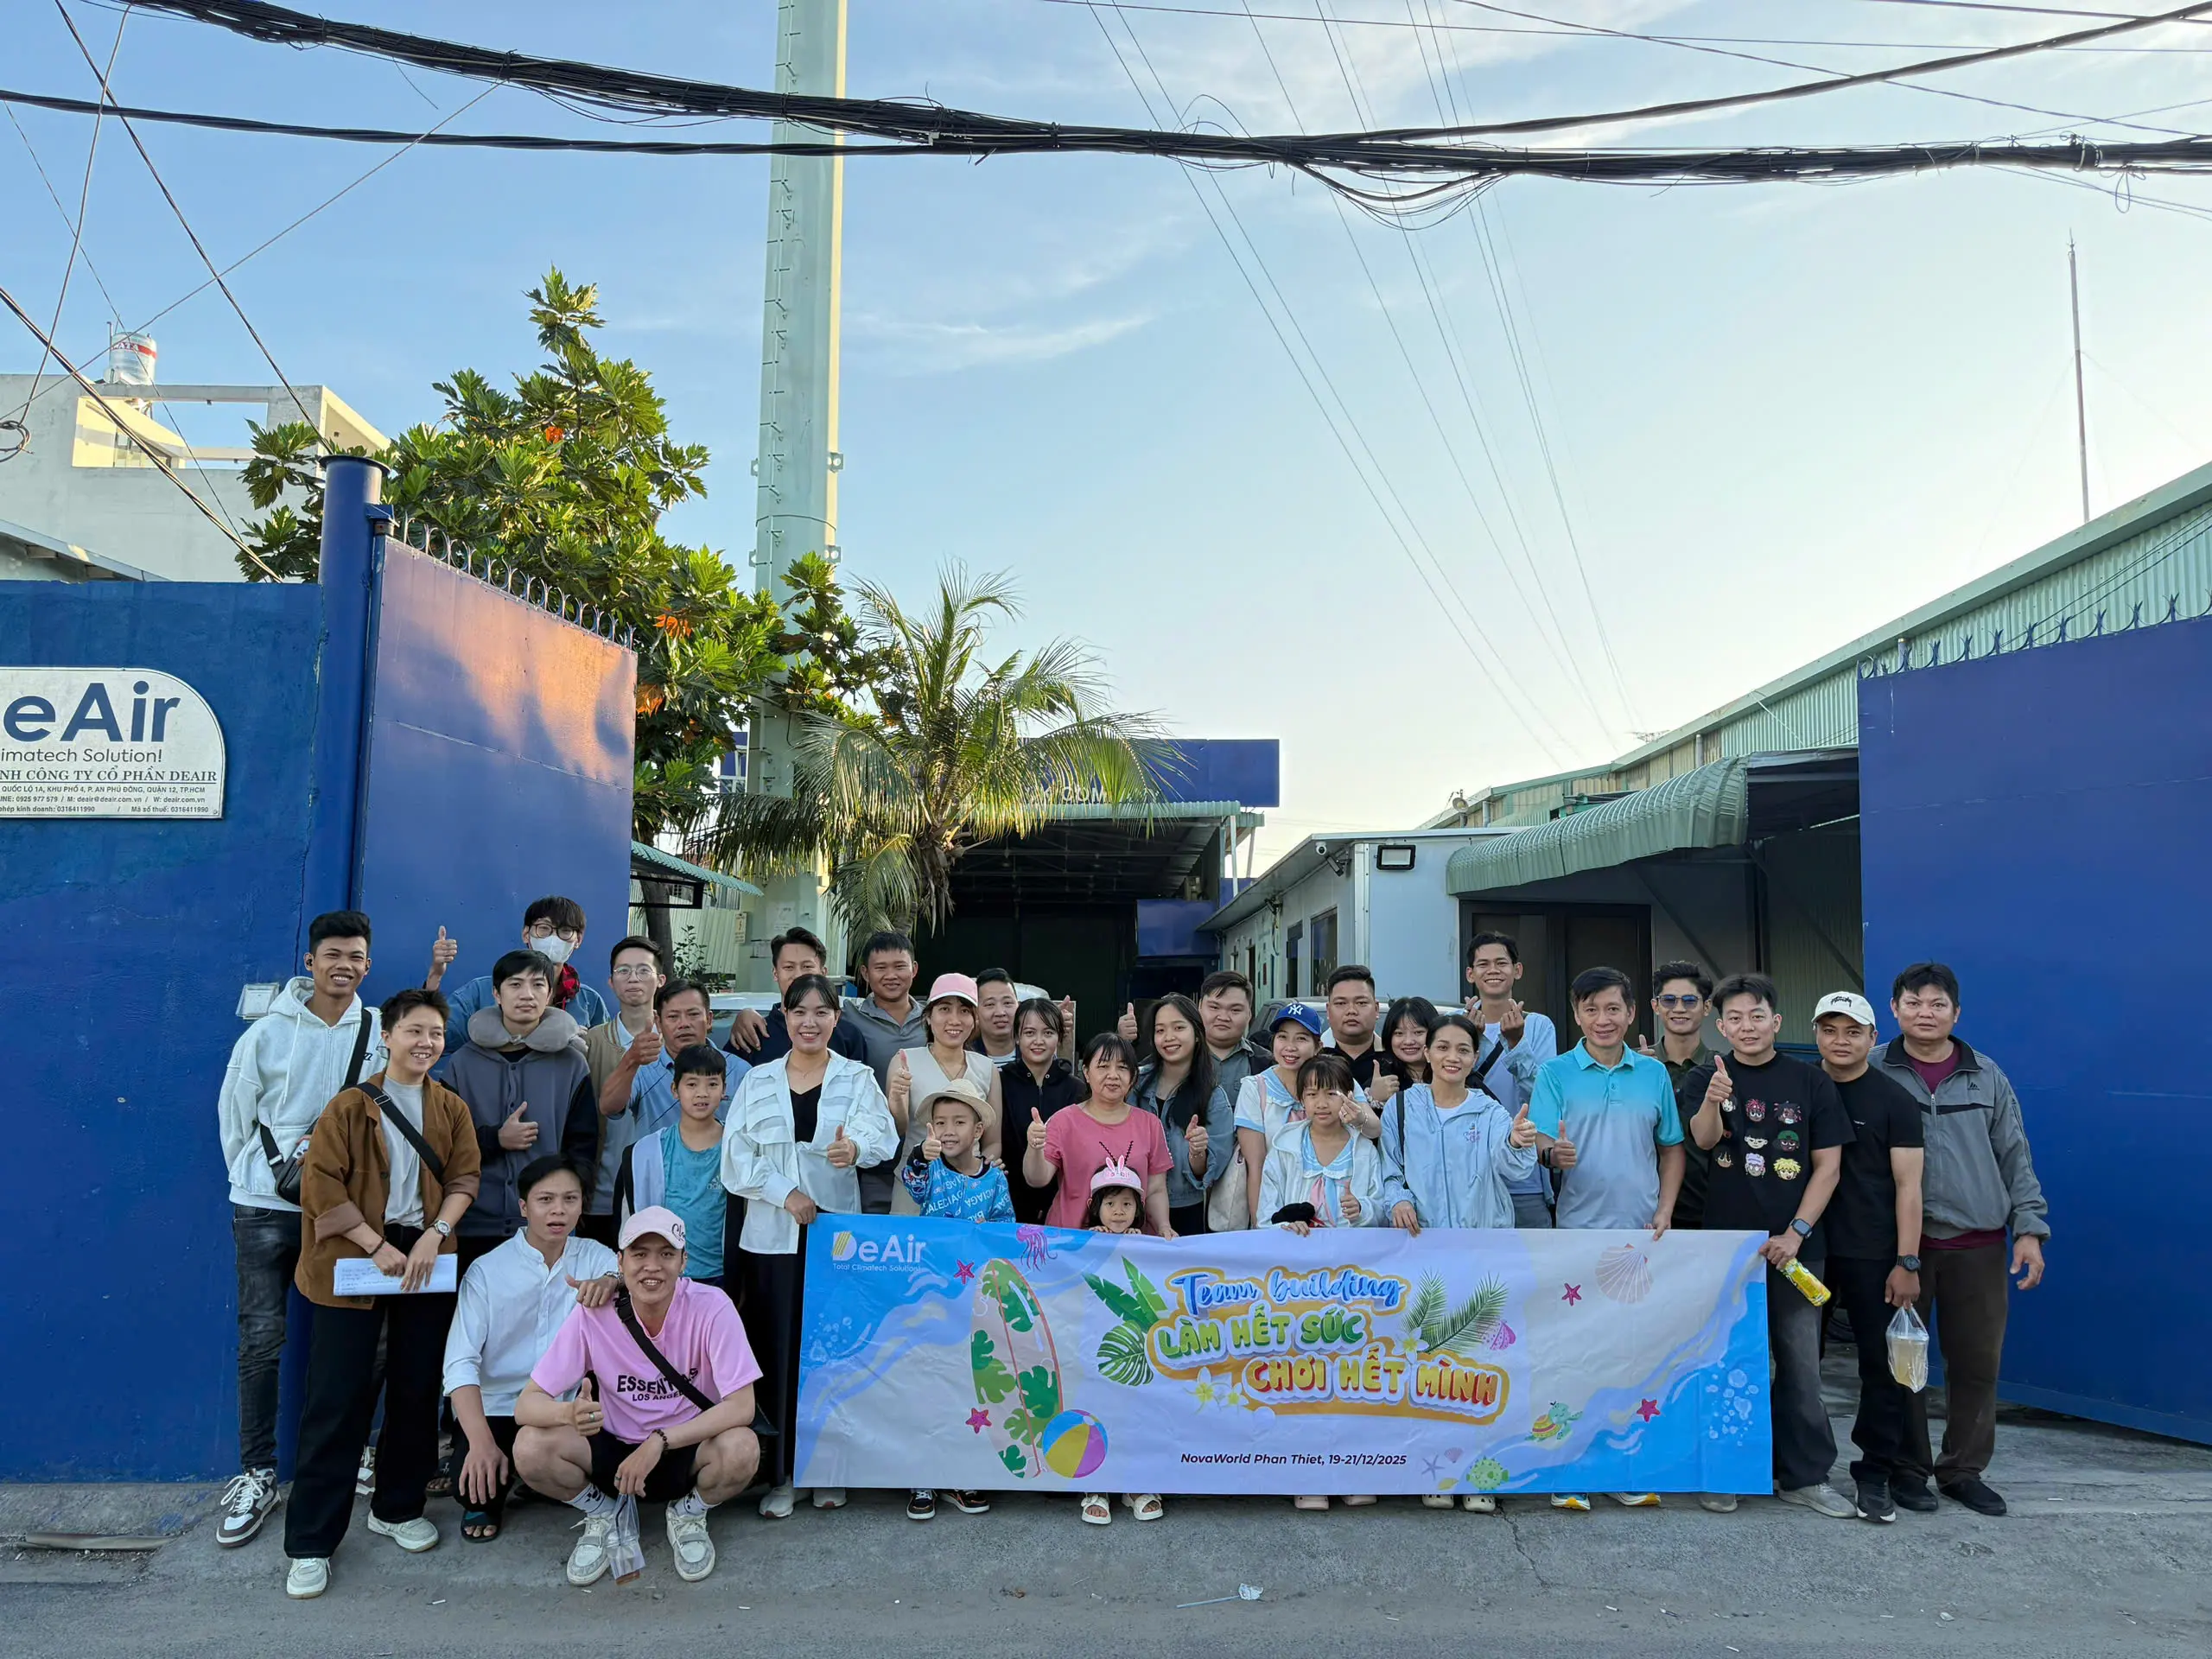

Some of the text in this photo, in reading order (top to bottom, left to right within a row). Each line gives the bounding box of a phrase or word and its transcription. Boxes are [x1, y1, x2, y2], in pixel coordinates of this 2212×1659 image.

[3, 681, 181, 742] eAir
[2, 748, 162, 762] imatech Solution!
[26, 767, 69, 780] CÔNG
[73, 770, 92, 780] TY
[98, 766, 119, 780] CỔ
[123, 766, 164, 781] PHẦN
[169, 771, 217, 781] DEAIR
[147, 785, 167, 794] QUẬN
[832, 1230, 926, 1263] DeAir
[852, 1263, 887, 1272] Climatech
[889, 1264, 920, 1273] Solution!
[1171, 1269, 1406, 1316] Team building
[1158, 1304, 1364, 1359] LÀM HẾT SỨC
[1245, 1345, 1499, 1406] CHƠI HẾT MÌNH
[1180, 1453, 1407, 1466] NovaWorld Phan Thiet, 19-21/12/2025
